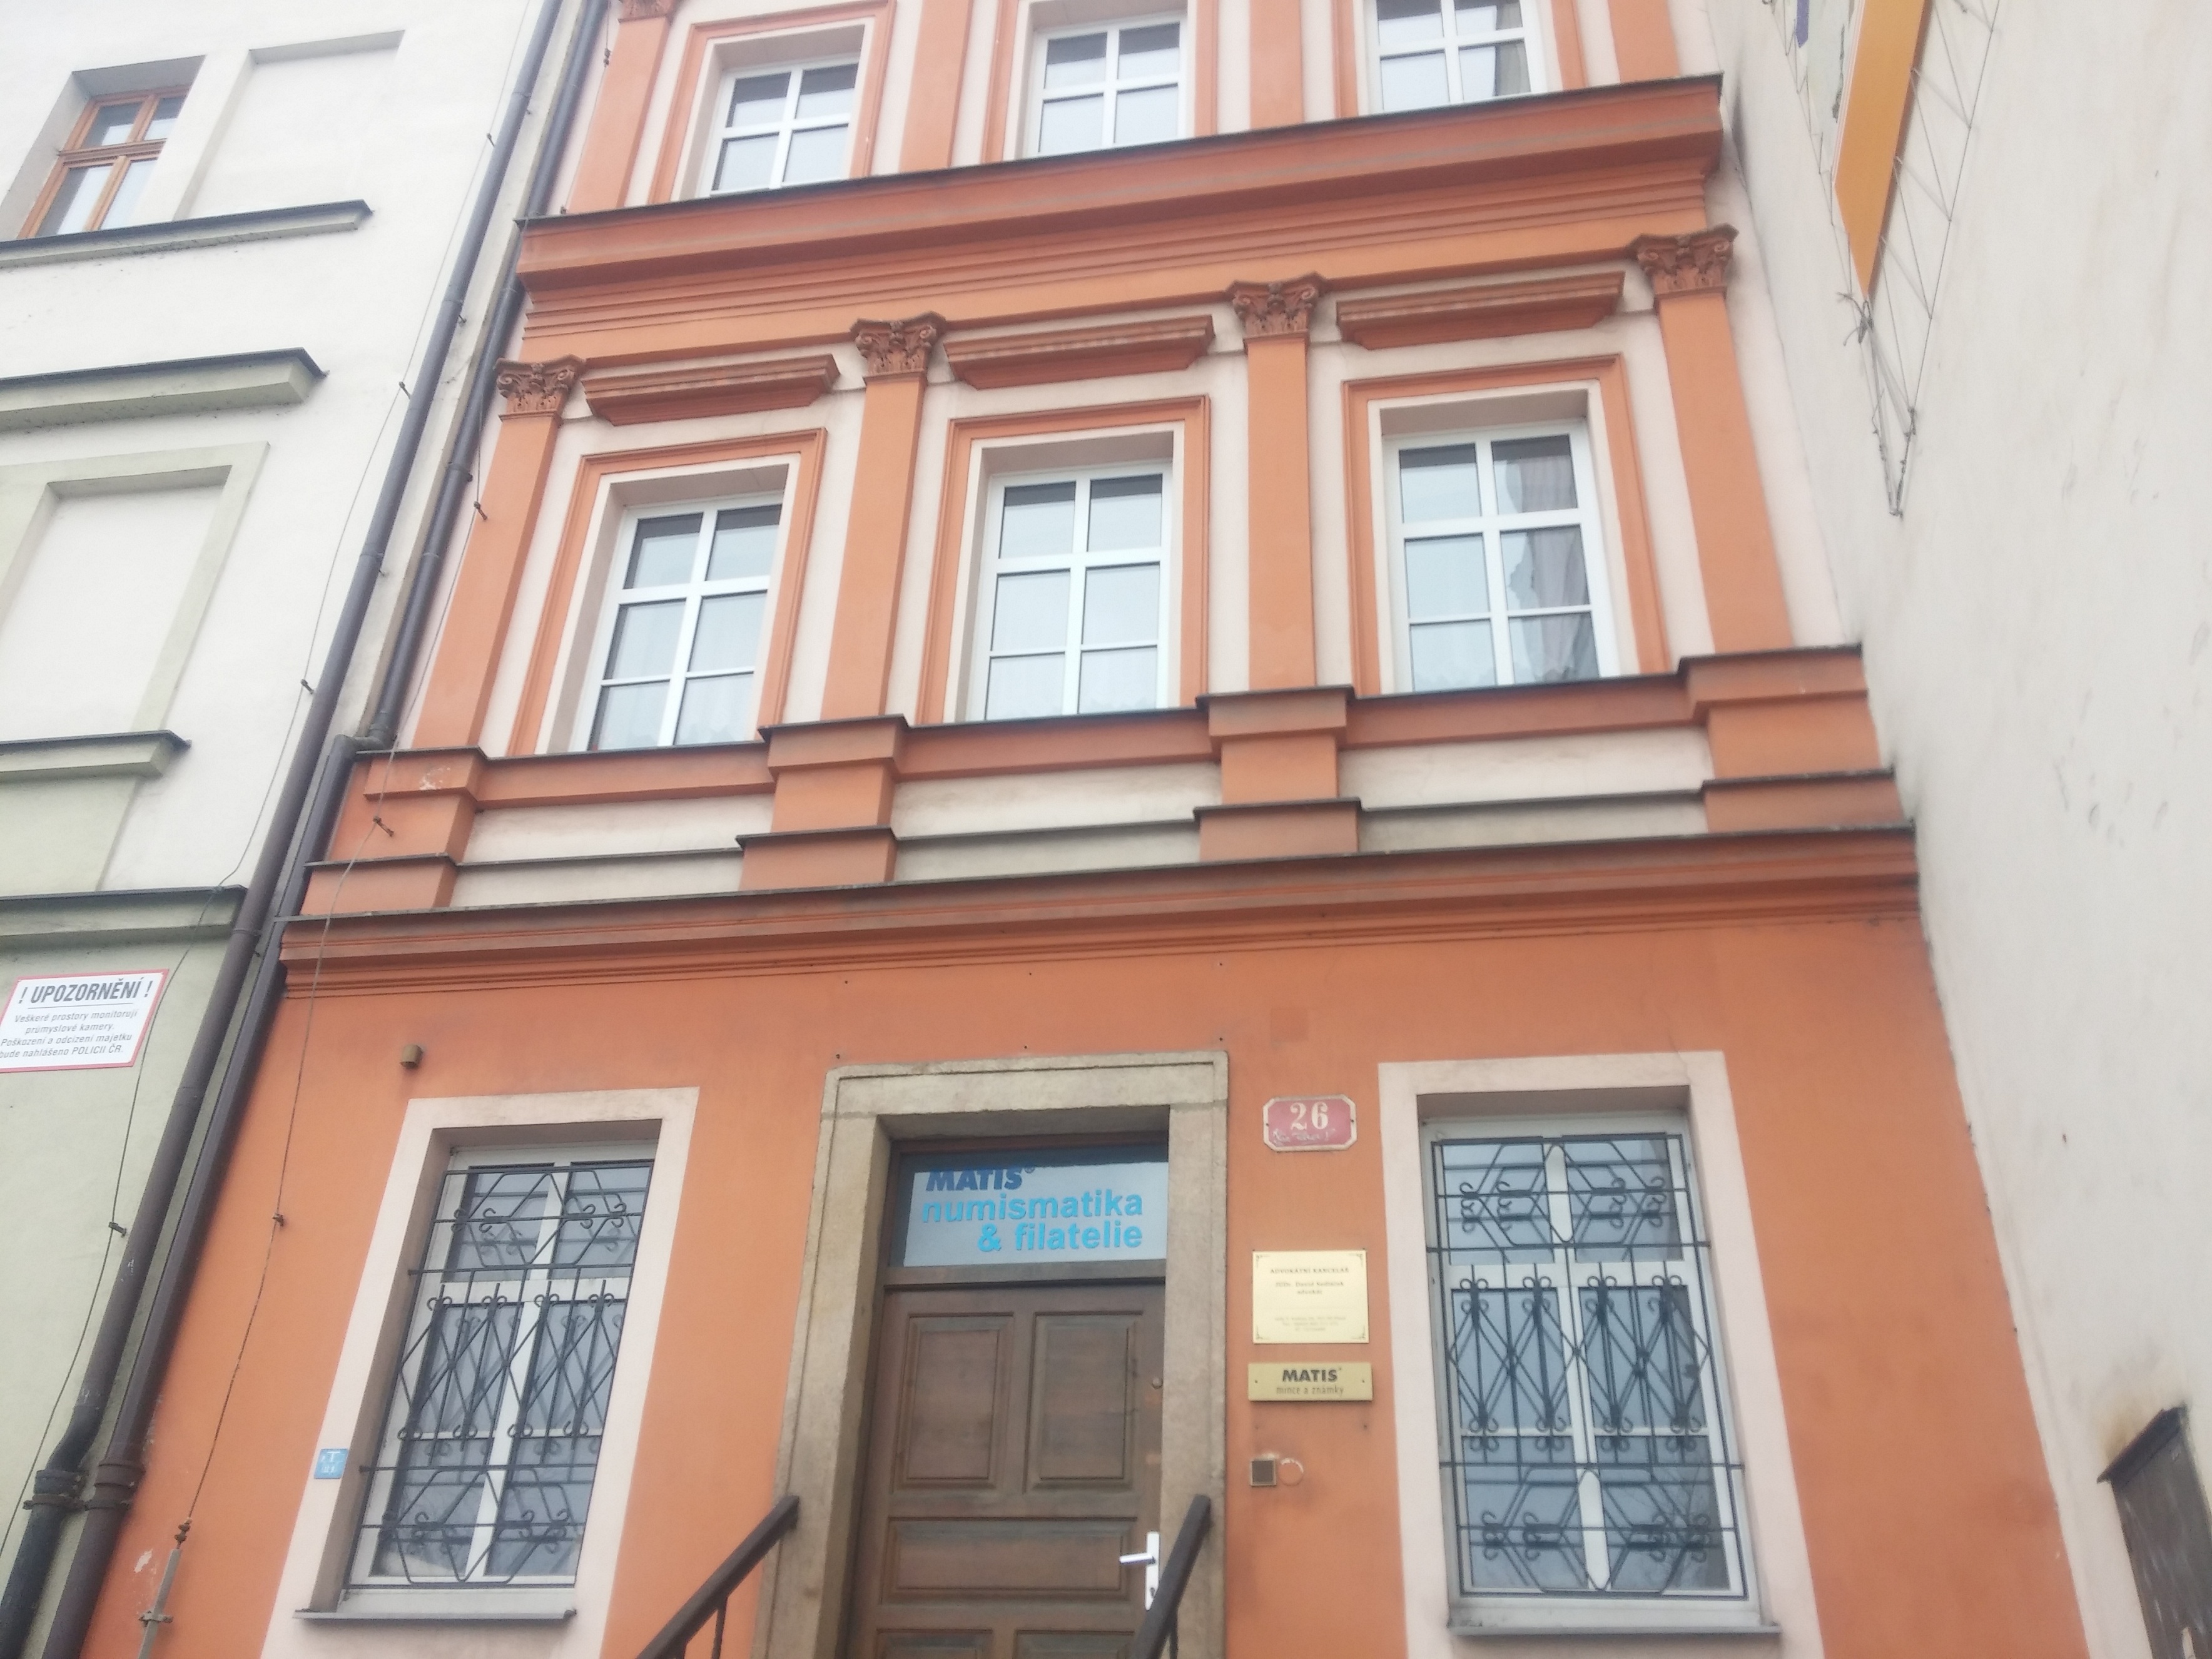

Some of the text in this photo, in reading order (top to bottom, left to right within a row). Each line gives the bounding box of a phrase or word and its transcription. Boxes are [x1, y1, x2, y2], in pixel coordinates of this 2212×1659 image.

[31, 977, 144, 1003] UPOZORNĚNÍ
[14, 1013, 50, 1023] Veškeré
[51, 1012, 89, 1023] prostory
[1, 1036, 47, 1046] Poškození
[95, 1033, 133, 1043] majetku
[71, 1045, 106, 1055] POLICII
[1289, 1101, 1329, 1131] 26
[923, 1189, 1142, 1222] numismatika
[977, 1220, 1142, 1252] & filatelie
[1303, 1386, 1309, 1395] a
